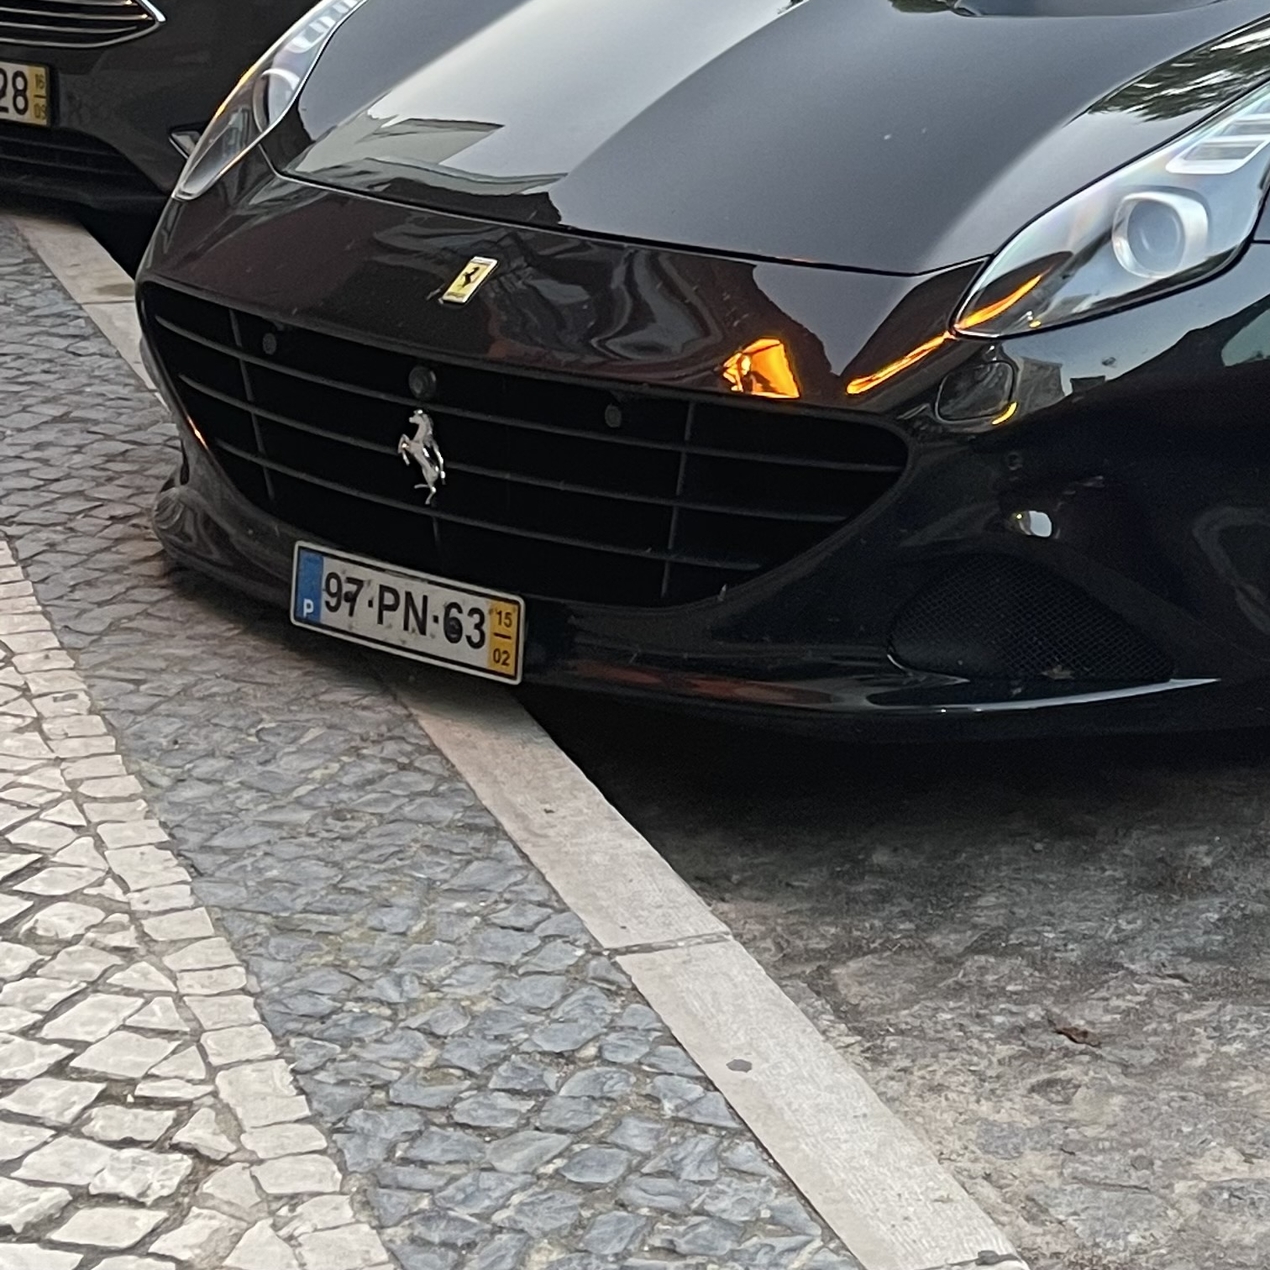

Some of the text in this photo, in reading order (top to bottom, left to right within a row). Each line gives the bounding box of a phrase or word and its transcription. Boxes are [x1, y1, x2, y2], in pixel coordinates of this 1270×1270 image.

[303, 597, 315, 618] P
[496, 610, 513, 628] 15
[492, 648, 511, 667] 02
